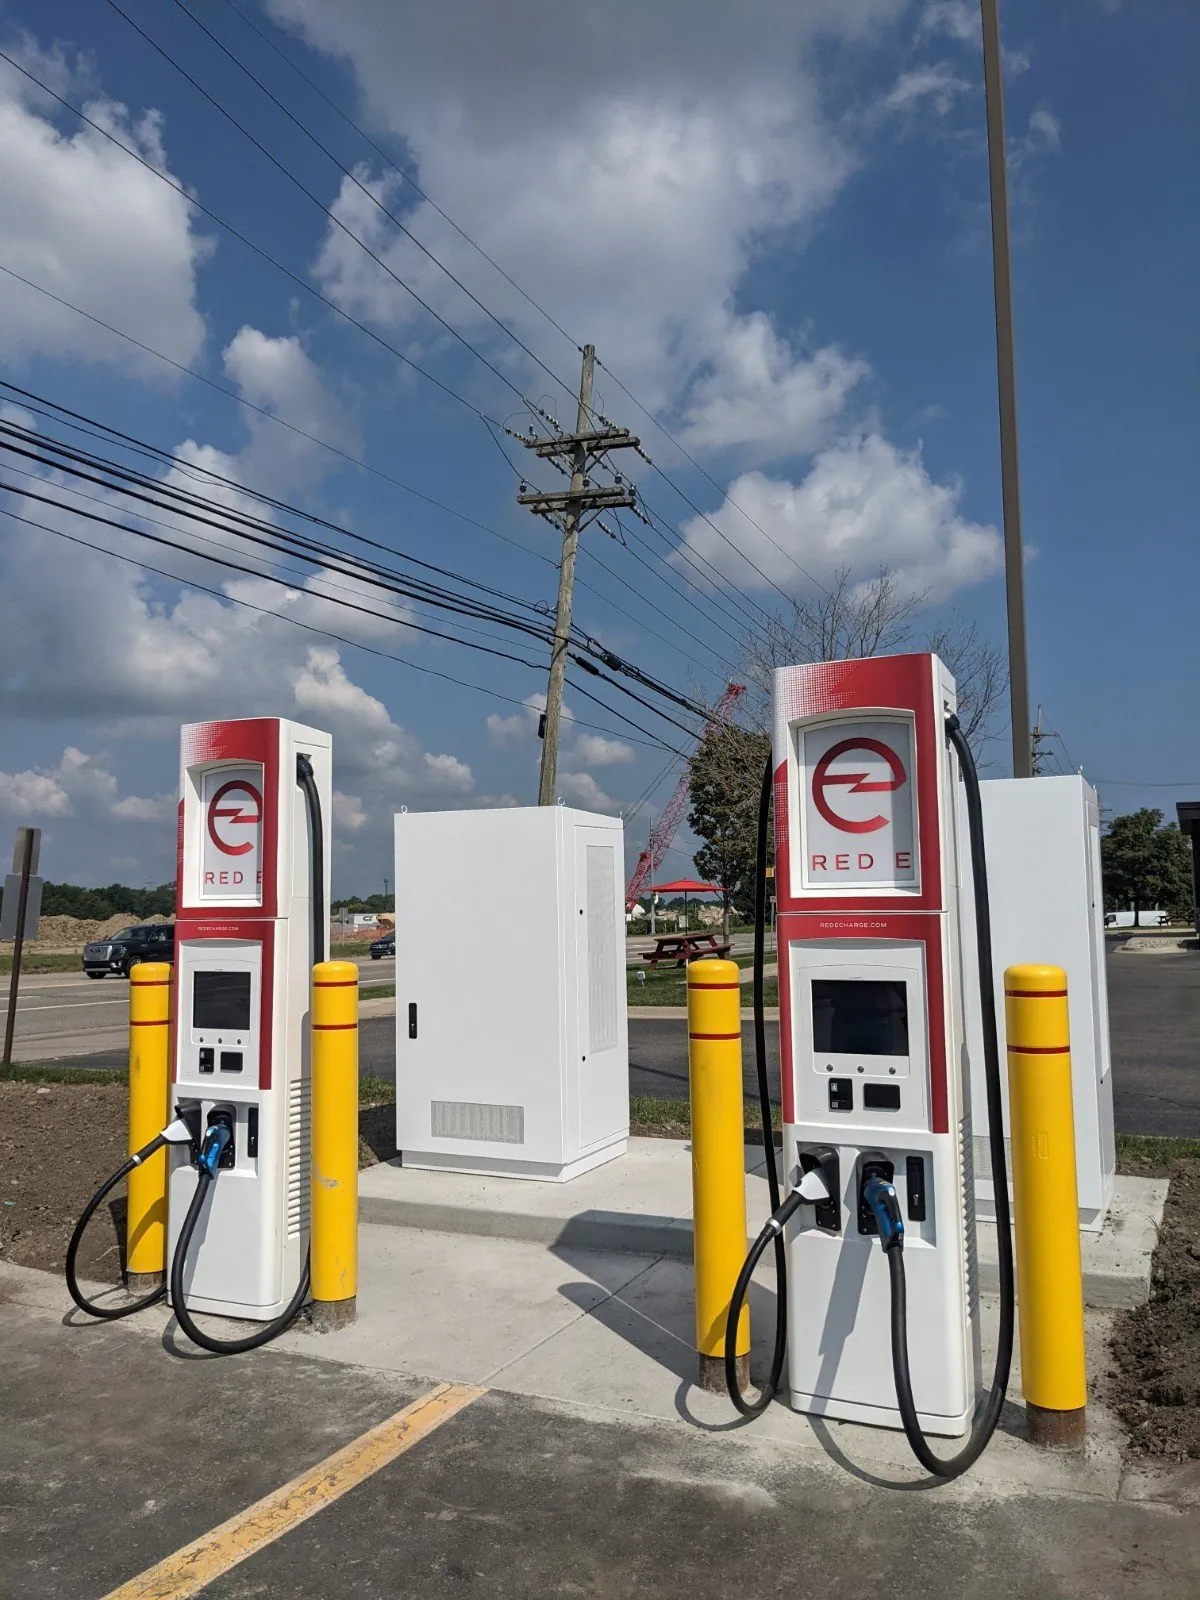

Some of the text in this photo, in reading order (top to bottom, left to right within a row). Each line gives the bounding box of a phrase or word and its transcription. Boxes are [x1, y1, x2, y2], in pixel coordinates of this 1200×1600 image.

[812, 852, 911, 871] RED E
[205, 871, 244, 885] RED
